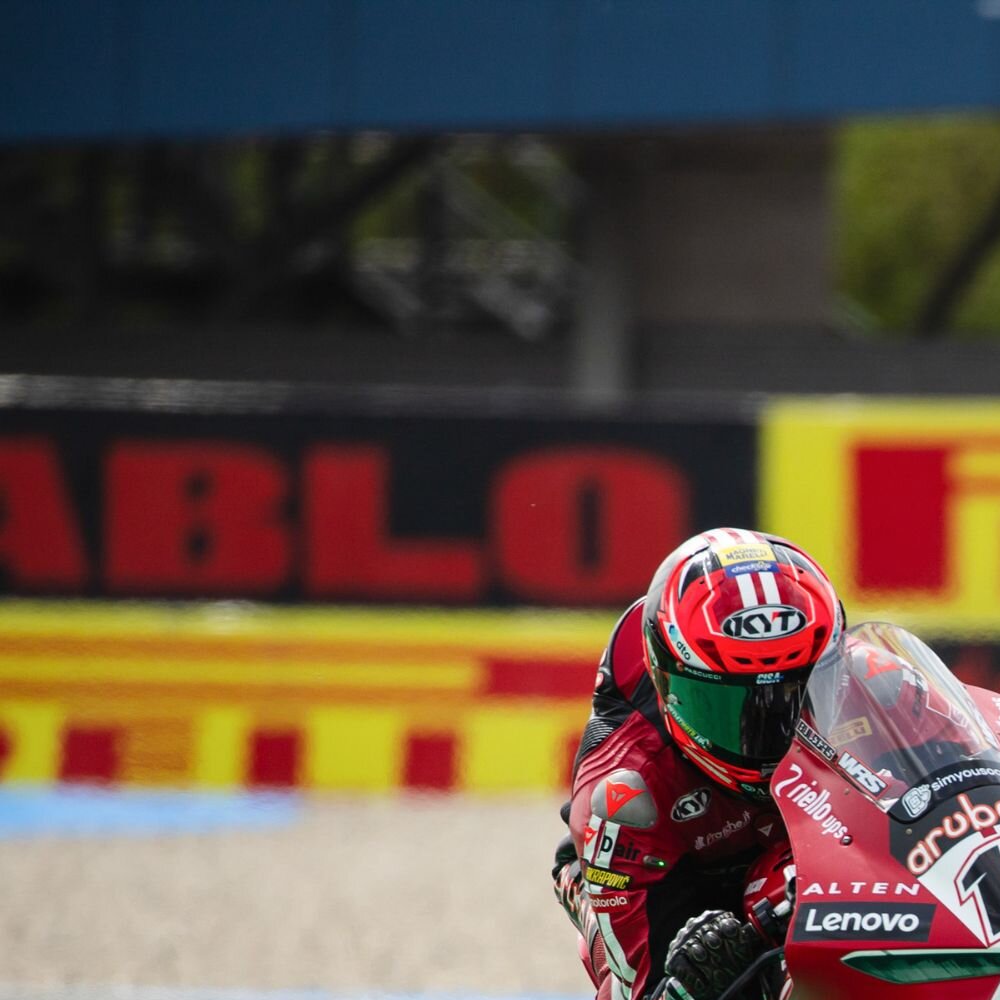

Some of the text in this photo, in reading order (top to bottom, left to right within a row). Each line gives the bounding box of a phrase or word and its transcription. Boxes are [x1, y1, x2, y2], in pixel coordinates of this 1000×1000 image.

[729, 610, 797, 637] KYT
[838, 751, 888, 794] WRS
[787, 779, 832, 822] riello
[821, 813, 848, 840] ups
[802, 881, 921, 896] ALTEN
[804, 907, 920, 933] Lenovo
